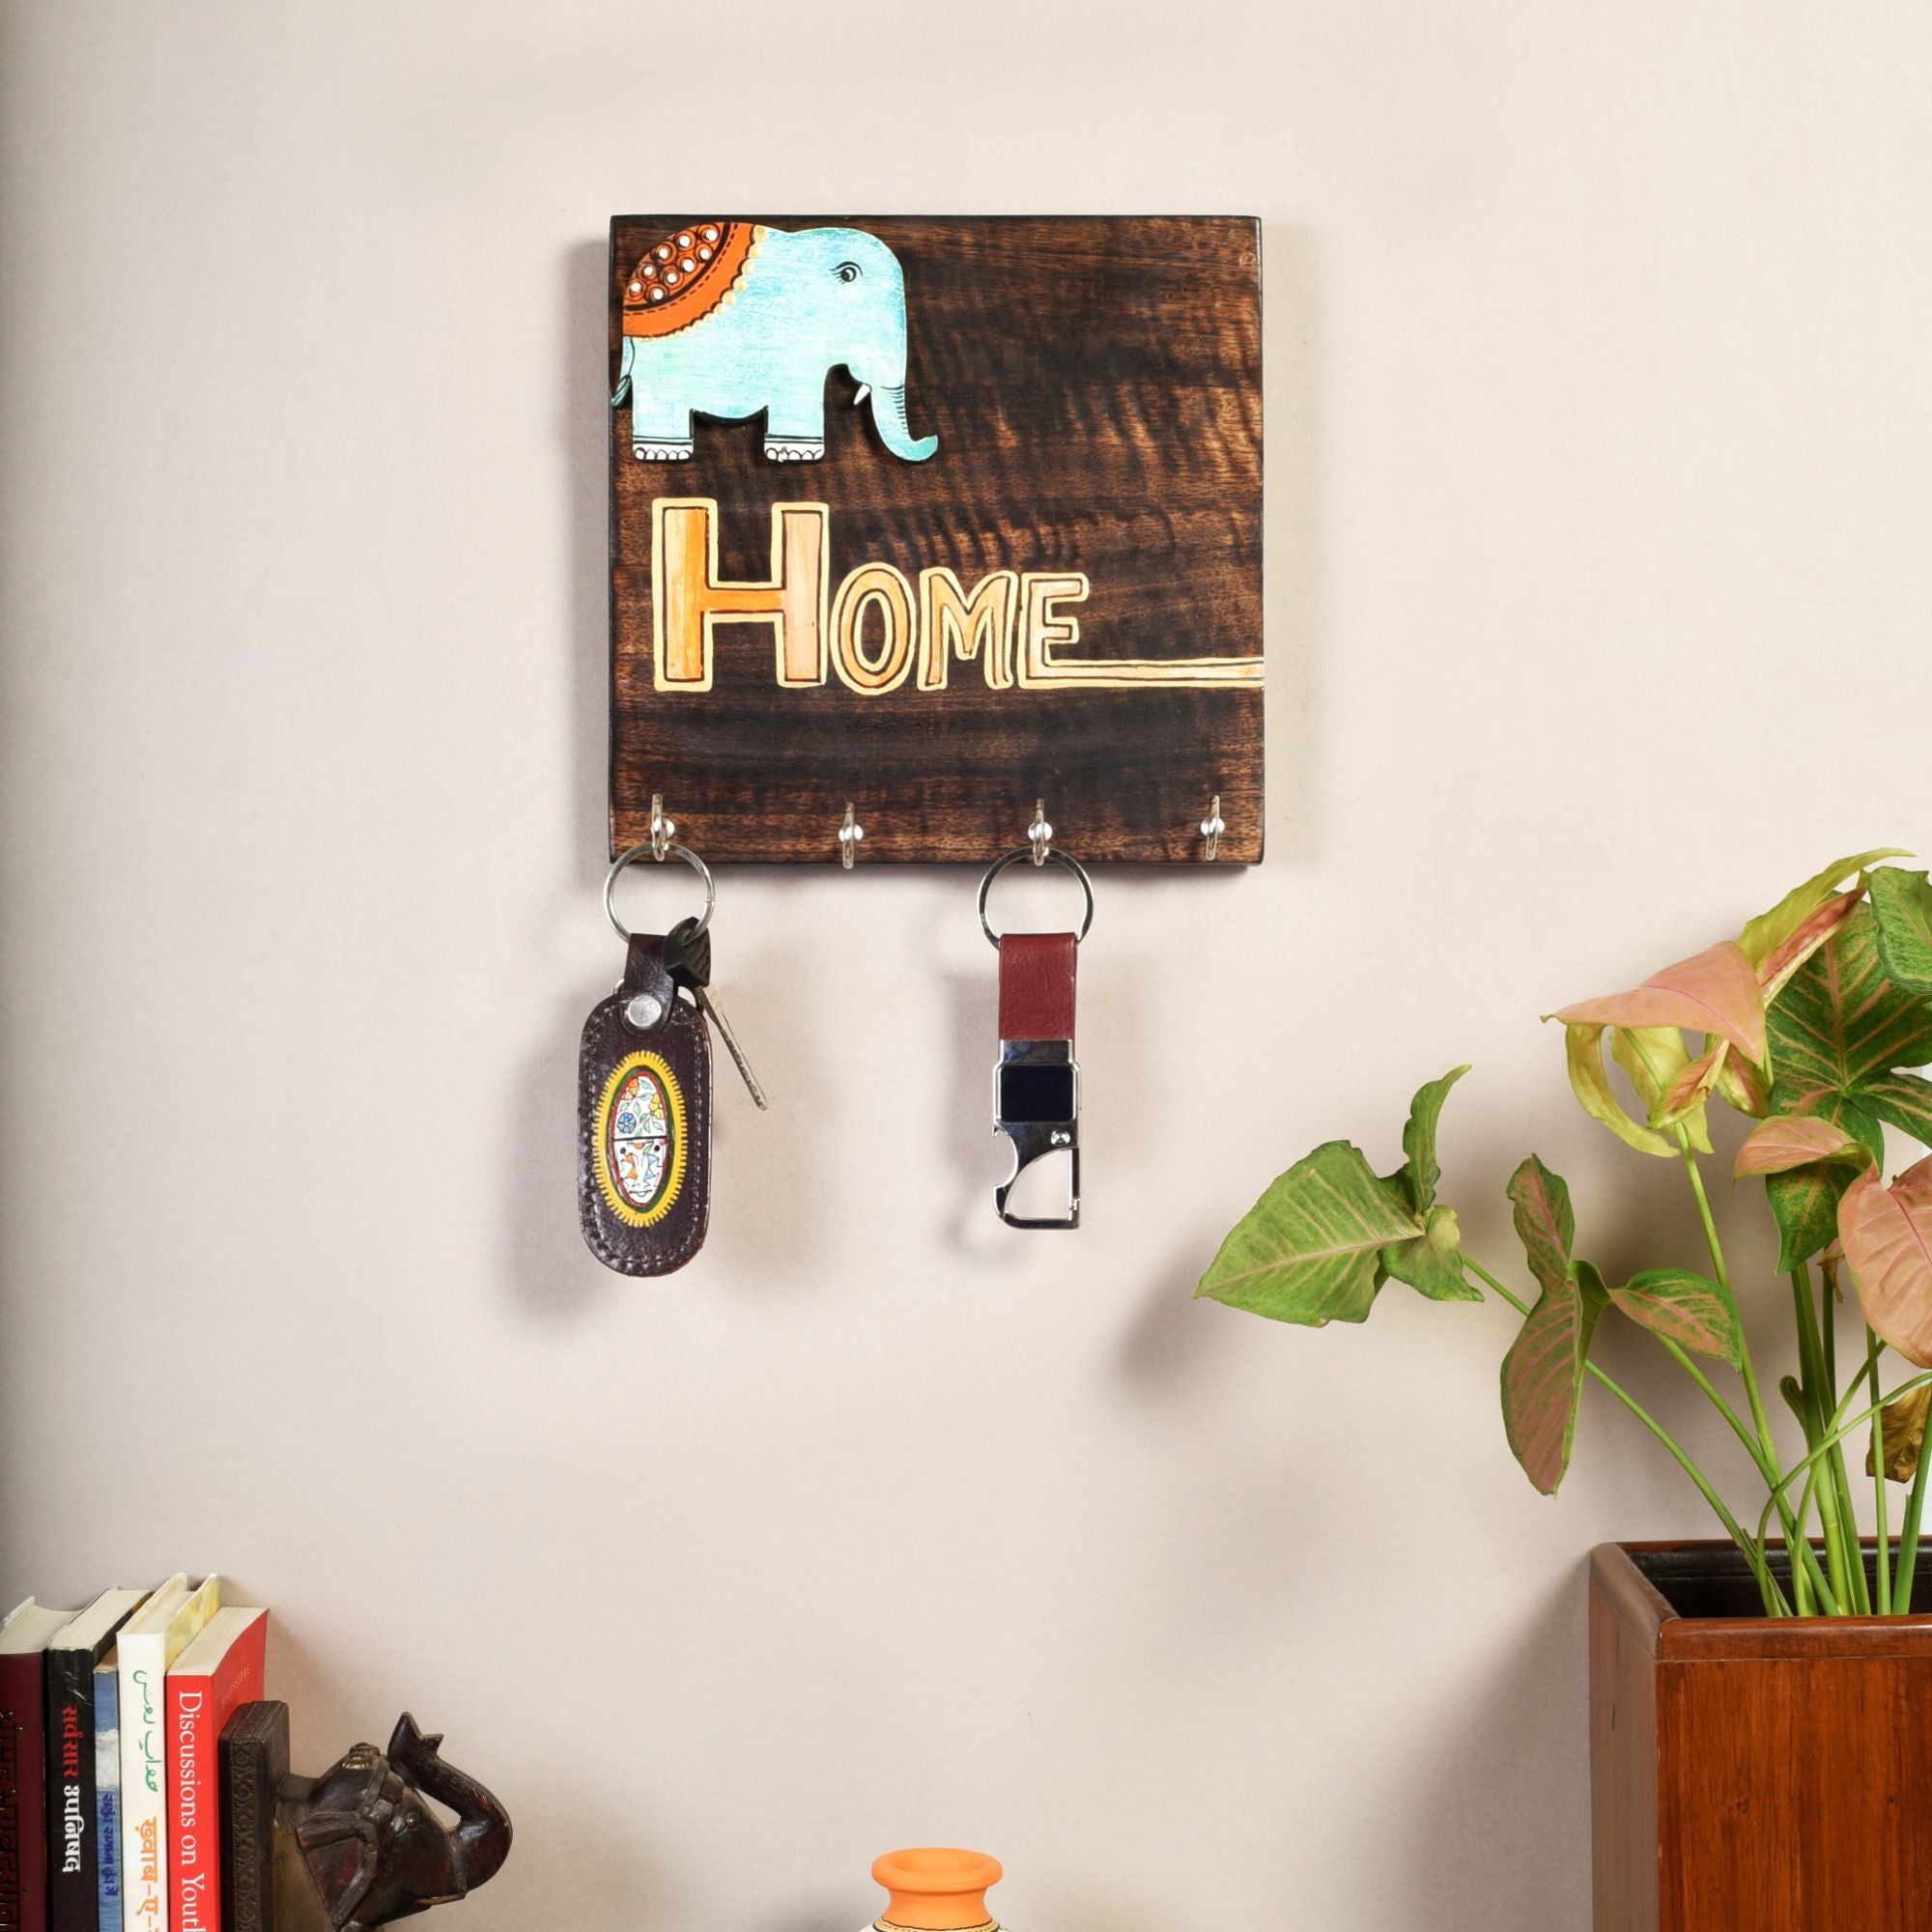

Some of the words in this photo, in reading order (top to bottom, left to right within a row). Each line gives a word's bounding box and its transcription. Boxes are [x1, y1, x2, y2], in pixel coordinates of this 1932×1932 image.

[62, 1705, 84, 1778] सर्वसार
[179, 1691, 203, 1828] Discussions
[62, 1785, 85, 1873] उपनिषद
[181, 1834, 196, 1866] on
[134, 1816, 158, 1932] ख़्वाब-ए-
